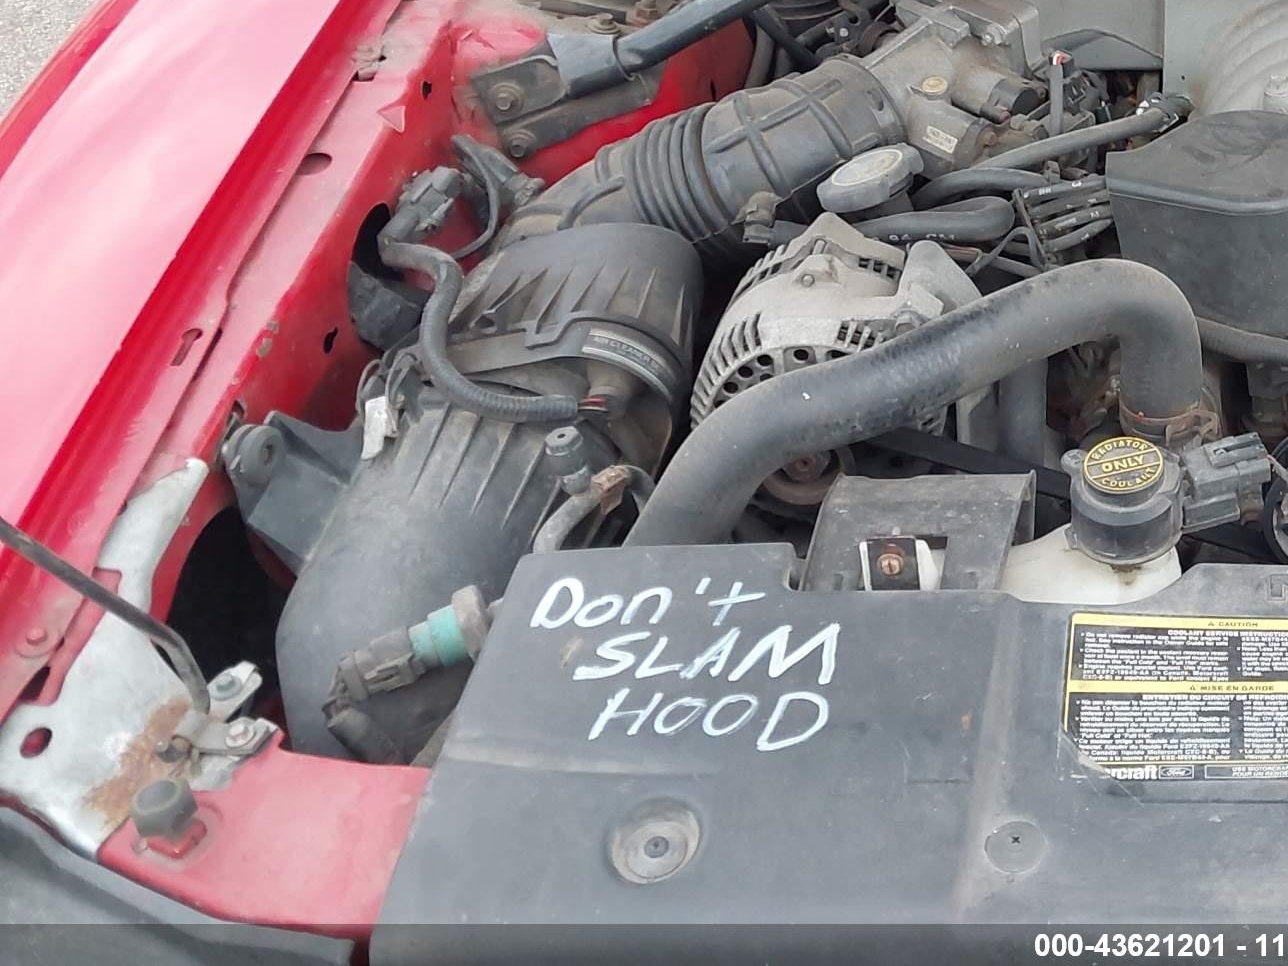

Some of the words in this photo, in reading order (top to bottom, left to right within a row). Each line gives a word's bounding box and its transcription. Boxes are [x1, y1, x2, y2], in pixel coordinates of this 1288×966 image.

[1091, 439, 1148, 460] RADIATOR
[1102, 454, 1145, 472] ONLY
[1102, 467, 1155, 487] COOLANT
[530, 577, 767, 629] Don't
[572, 621, 841, 686] SLAM
[588, 687, 829, 752] HOOD
